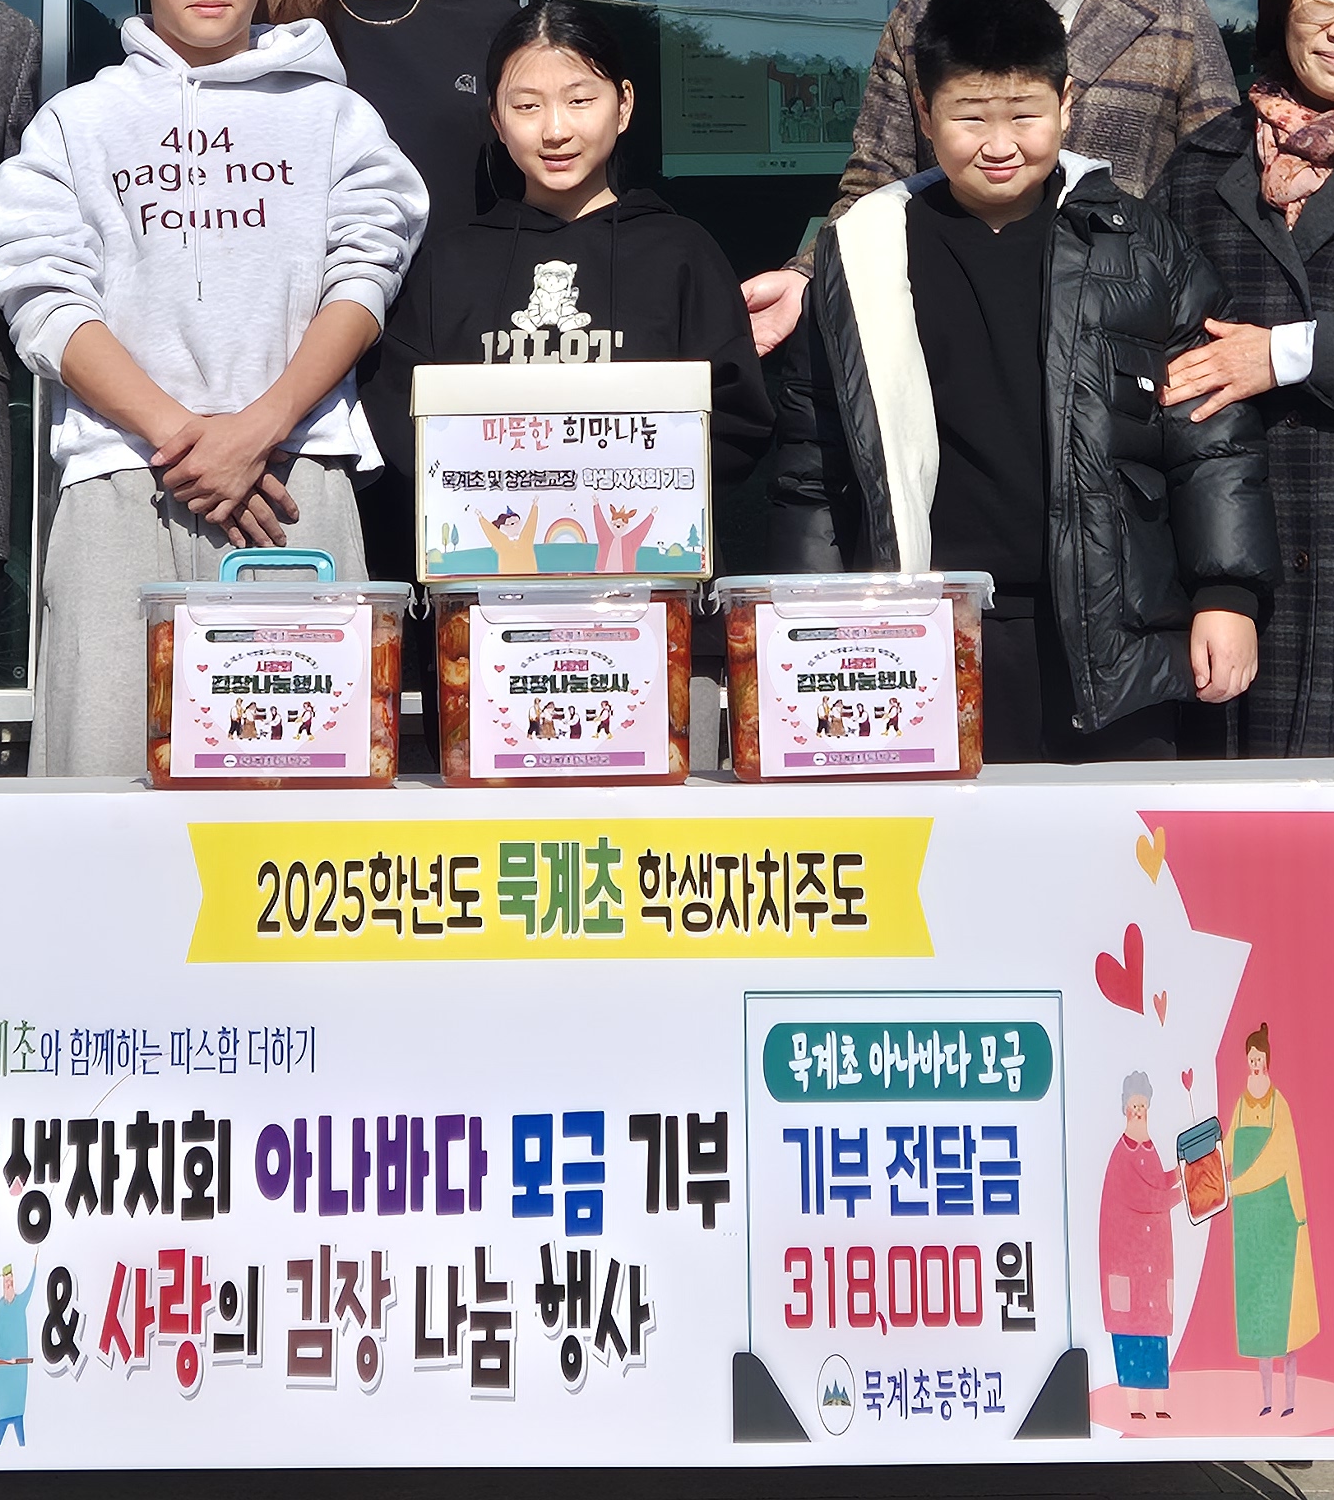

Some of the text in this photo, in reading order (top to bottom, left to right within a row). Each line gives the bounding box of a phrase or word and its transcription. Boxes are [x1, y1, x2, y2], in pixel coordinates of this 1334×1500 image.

[160, 126, 235, 157] 404
[112, 159, 295, 207] page not
[139, 197, 267, 236] Found
[480, 329, 624, 365] PILOT
[482, 415, 658, 451] 따뜻한 희망나눔
[487, 469, 503, 491] 및
[257, 836, 868, 936] 2025학년도 묵계초 학생자치주도
[69, 1028, 163, 1076] 함께하는
[169, 1027, 239, 1075] 따스함
[246, 1025, 317, 1074] 더하기
[787, 1030, 1027, 1093] 묵계초 아나바다 모금
[254, 1113, 489, 1217] 아나바다
[510, 1110, 605, 1236] 모금
[628, 1109, 731, 1230] 기부
[782, 1123, 1023, 1218] 기부 전달금
[41, 1240, 651, 1390] & 사랑의 김장 나눔 행사
[783, 1240, 1037, 1337] 318,000 원
[862, 1366, 1006, 1422] 묵계초등학교
